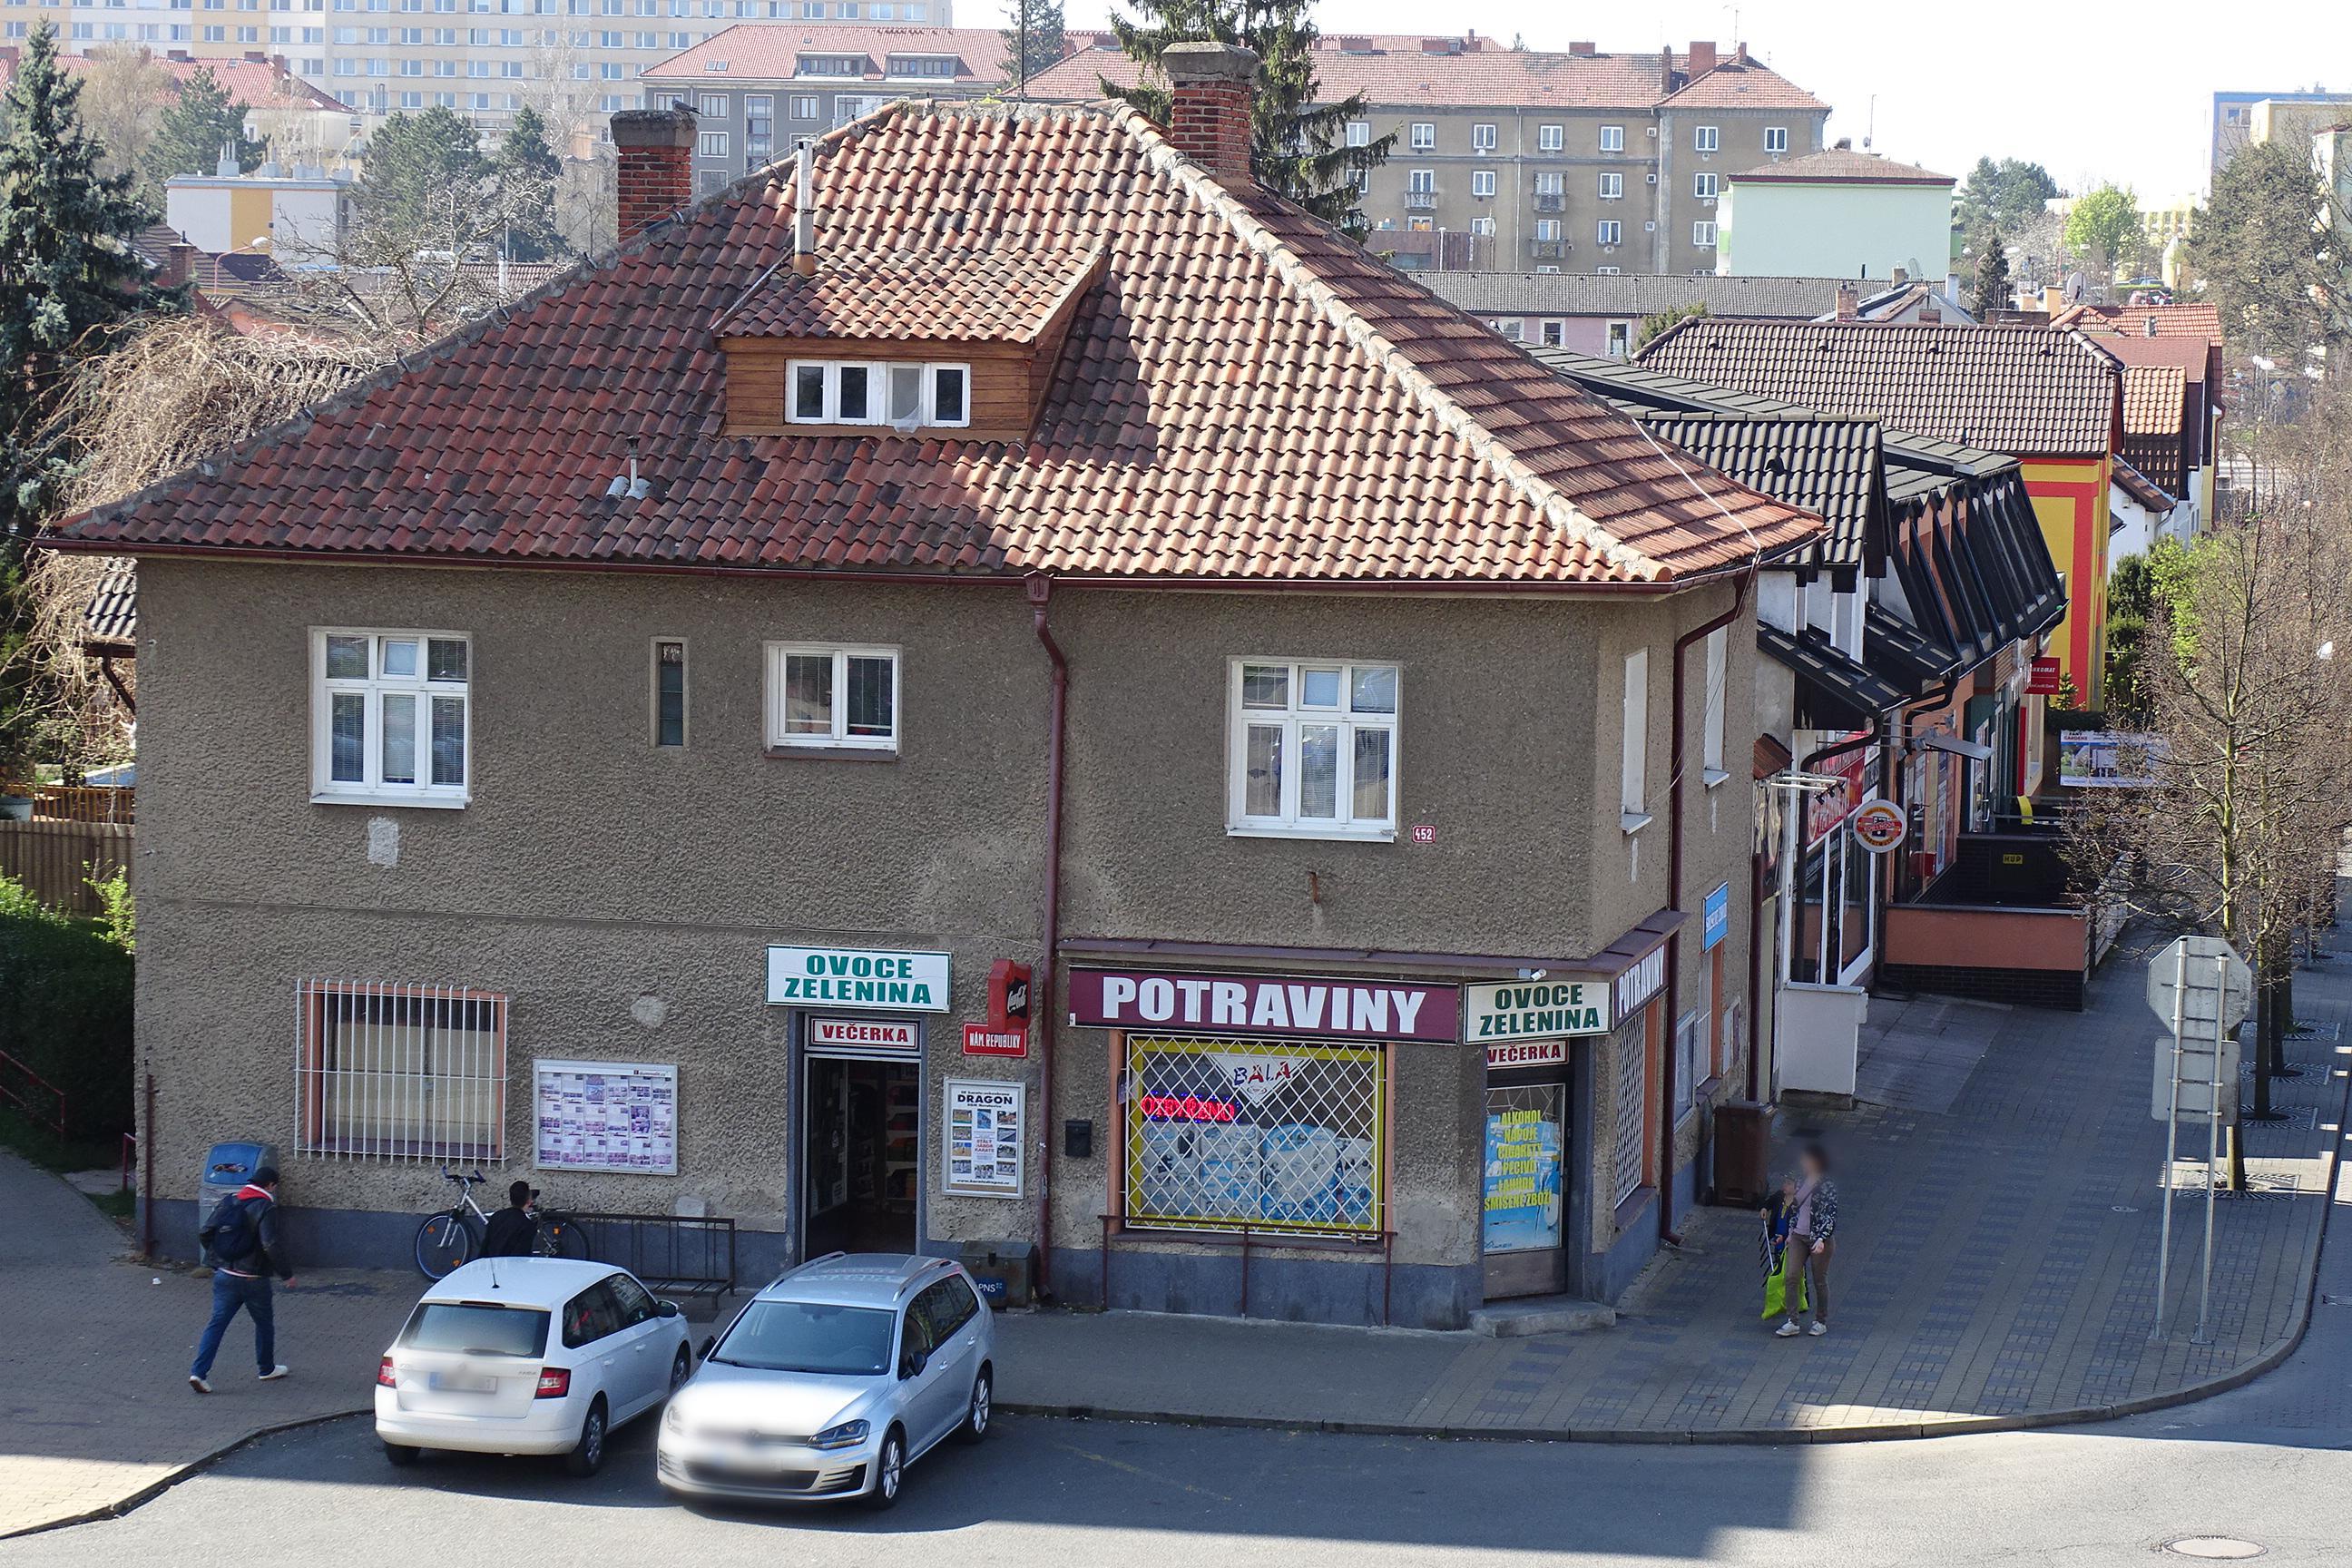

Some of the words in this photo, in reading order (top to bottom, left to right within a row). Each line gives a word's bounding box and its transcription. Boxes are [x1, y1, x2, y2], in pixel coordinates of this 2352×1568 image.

[1416, 828, 1432, 840] 452
[806, 955, 913, 979] OVOCE
[784, 977, 932, 1004] ZELENINA
[1618, 944, 1665, 1019] POTRAVINY
[1102, 976, 1426, 1034] POTRAVINY
[1494, 984, 1583, 1010] OVOCE
[1479, 1007, 1600, 1036] ZELENINA
[822, 1024, 908, 1043] VEČERKA
[985, 1033, 1021, 1049] REPUBLIKY
[1487, 1044, 1561, 1063] VEČERKA
[957, 1094, 1013, 1105] DRAGON
[1498, 1142, 1543, 1160] CIGARETY
[978, 1283, 996, 1293] PNS
